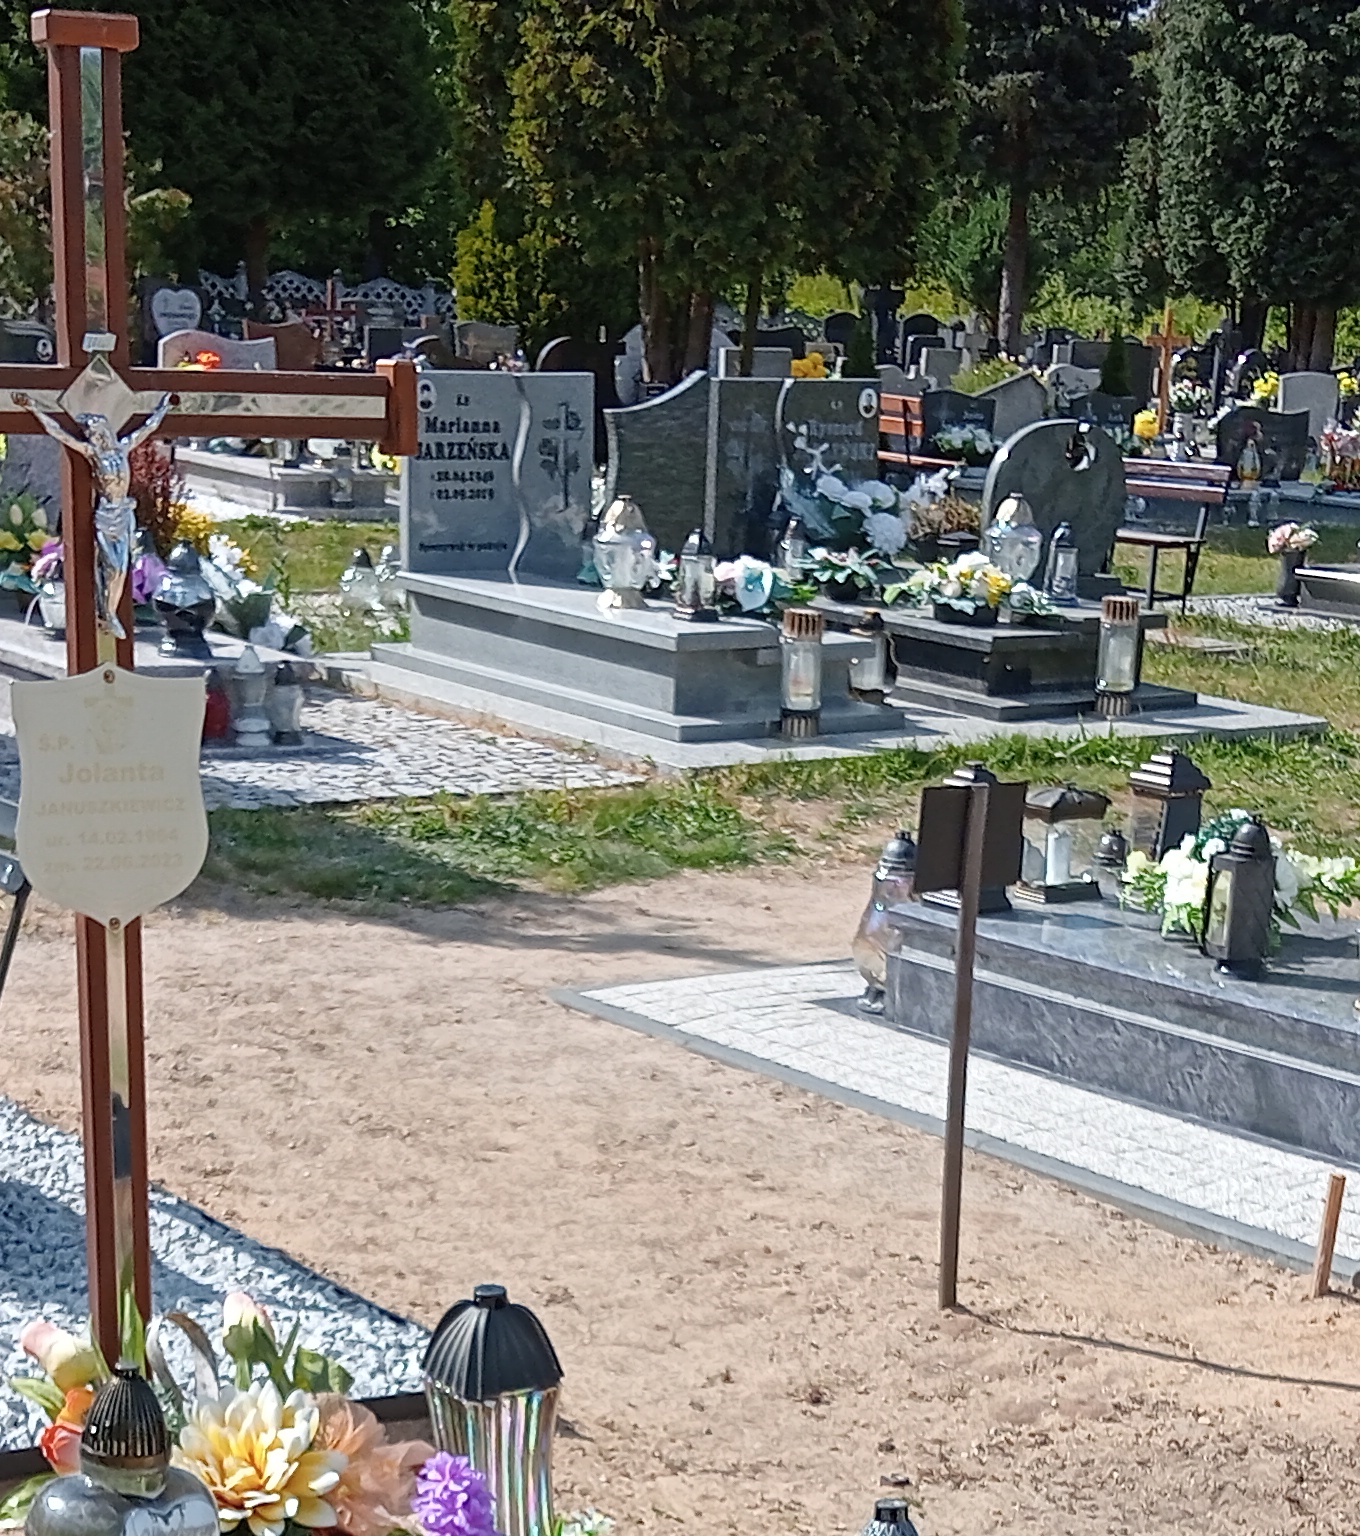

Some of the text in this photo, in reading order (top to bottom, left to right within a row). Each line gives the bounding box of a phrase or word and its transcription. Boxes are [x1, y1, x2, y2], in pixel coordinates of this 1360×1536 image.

[425, 416, 501, 433] Marianna
[415, 436, 510, 461] JARZEŃSKA
[58, 761, 165, 784] Jolanta
